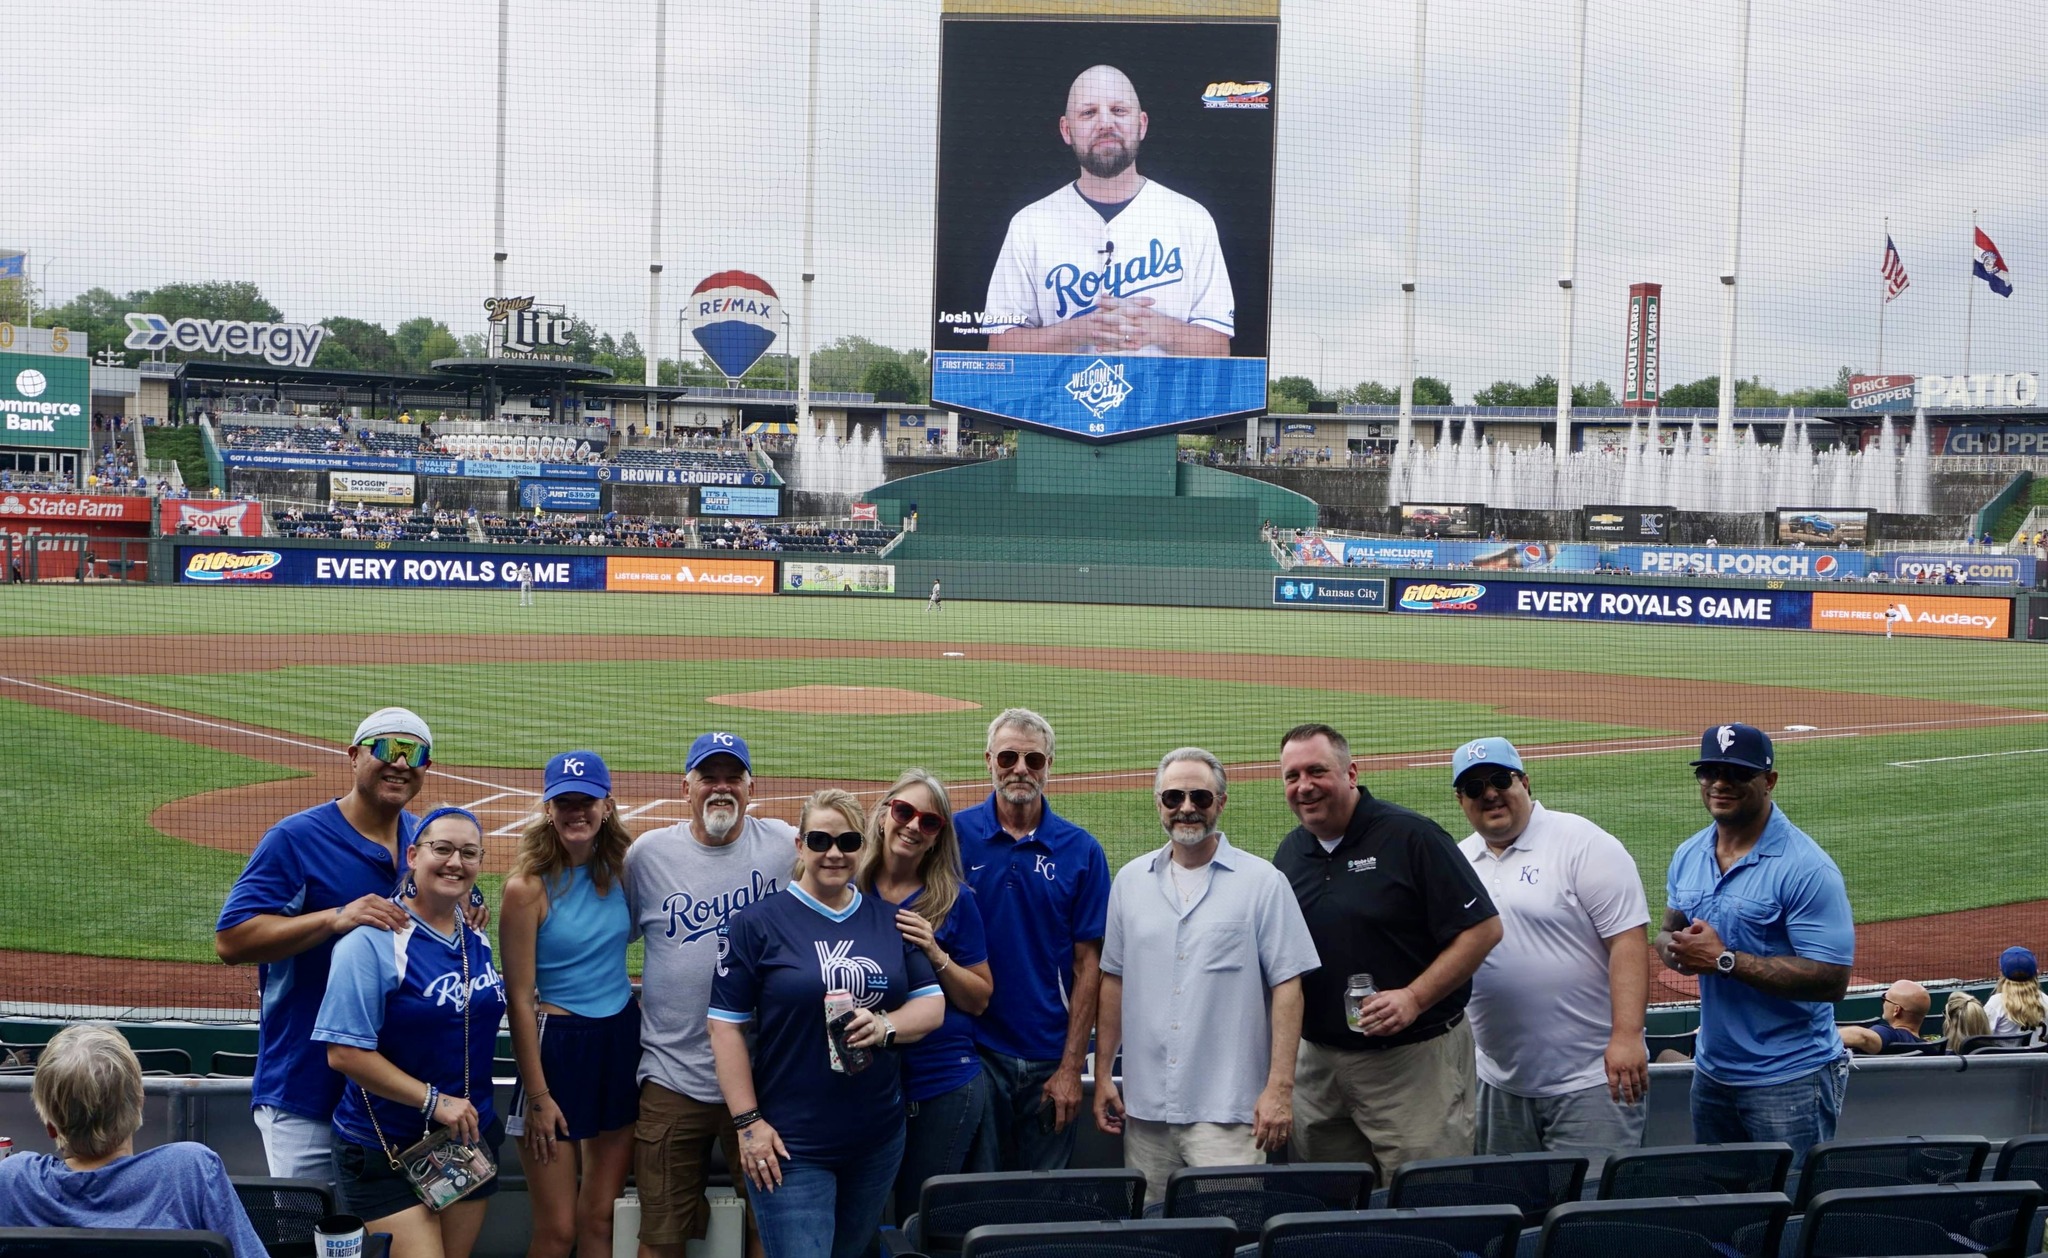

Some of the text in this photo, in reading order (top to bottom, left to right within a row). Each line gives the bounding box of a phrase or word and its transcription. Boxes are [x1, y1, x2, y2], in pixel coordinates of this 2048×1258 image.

[1045, 238, 1184, 318] Royals
[699, 298, 771, 319] RE/MAX
[939, 311, 1028, 325] Josh Vernier
[51, 327, 70, 353] 5
[502, 309, 574, 353] Lite
[953, 327, 979, 335] Royals
[175, 321, 323, 363] evergy
[1627, 304, 1640, 392] BOULEVARD
[1645, 304, 1658, 392] BOULEVARD
[500, 352, 574, 362] OUNTAIN BAR
[942, 361, 961, 369] FIRST
[962, 361, 984, 370] PITCH:
[1072, 367, 1111, 389] WELCOME
[1088, 380, 1126, 408] City
[1850, 388, 1912, 411] CHOPPER
[1852, 372, 2039, 408] PRICE PATIO
[0, 399, 81, 416] ommerce
[6, 413, 55, 432] Bank
[1089, 423, 1105, 432] 6:43
[1951, 433, 2048, 453] CHOPPE
[621, 468, 665, 483] BROWN
[667, 470, 677, 483] &
[187, 514, 237, 530] SONIC
[375, 541, 391, 549] 387
[316, 558, 397, 580] EVERY
[403, 559, 495, 582] ROYALS
[1642, 552, 1809, 576] PEPSI PORCH
[222, 571, 273, 580] RADIO
[615, 572, 640, 580] LISTEN
[698, 572, 764, 587] Audacy
[1767, 580, 1785, 589] 387
[1318, 586, 1378, 600] Kansas City
[1432, 602, 1478, 610] RADIO
[1517, 590, 1772, 620] EVERY ROYALS GAME
[1821, 610, 1997, 629] LISTEN FREE ON Audacy
[712, 732, 733, 747] KC
[1467, 742, 1487, 761] KC
[563, 757, 585, 776] KC
[1034, 854, 1056, 881] KC
[1519, 865, 1539, 885] KC
[407, 885, 416, 896] KC
[471, 893, 482, 904] KC
[661, 869, 779, 940] Royals
[423, 961, 501, 1013] Royals
[326, 1248, 335, 1258] THE
[335, 1247, 354, 1258] FASTEST
